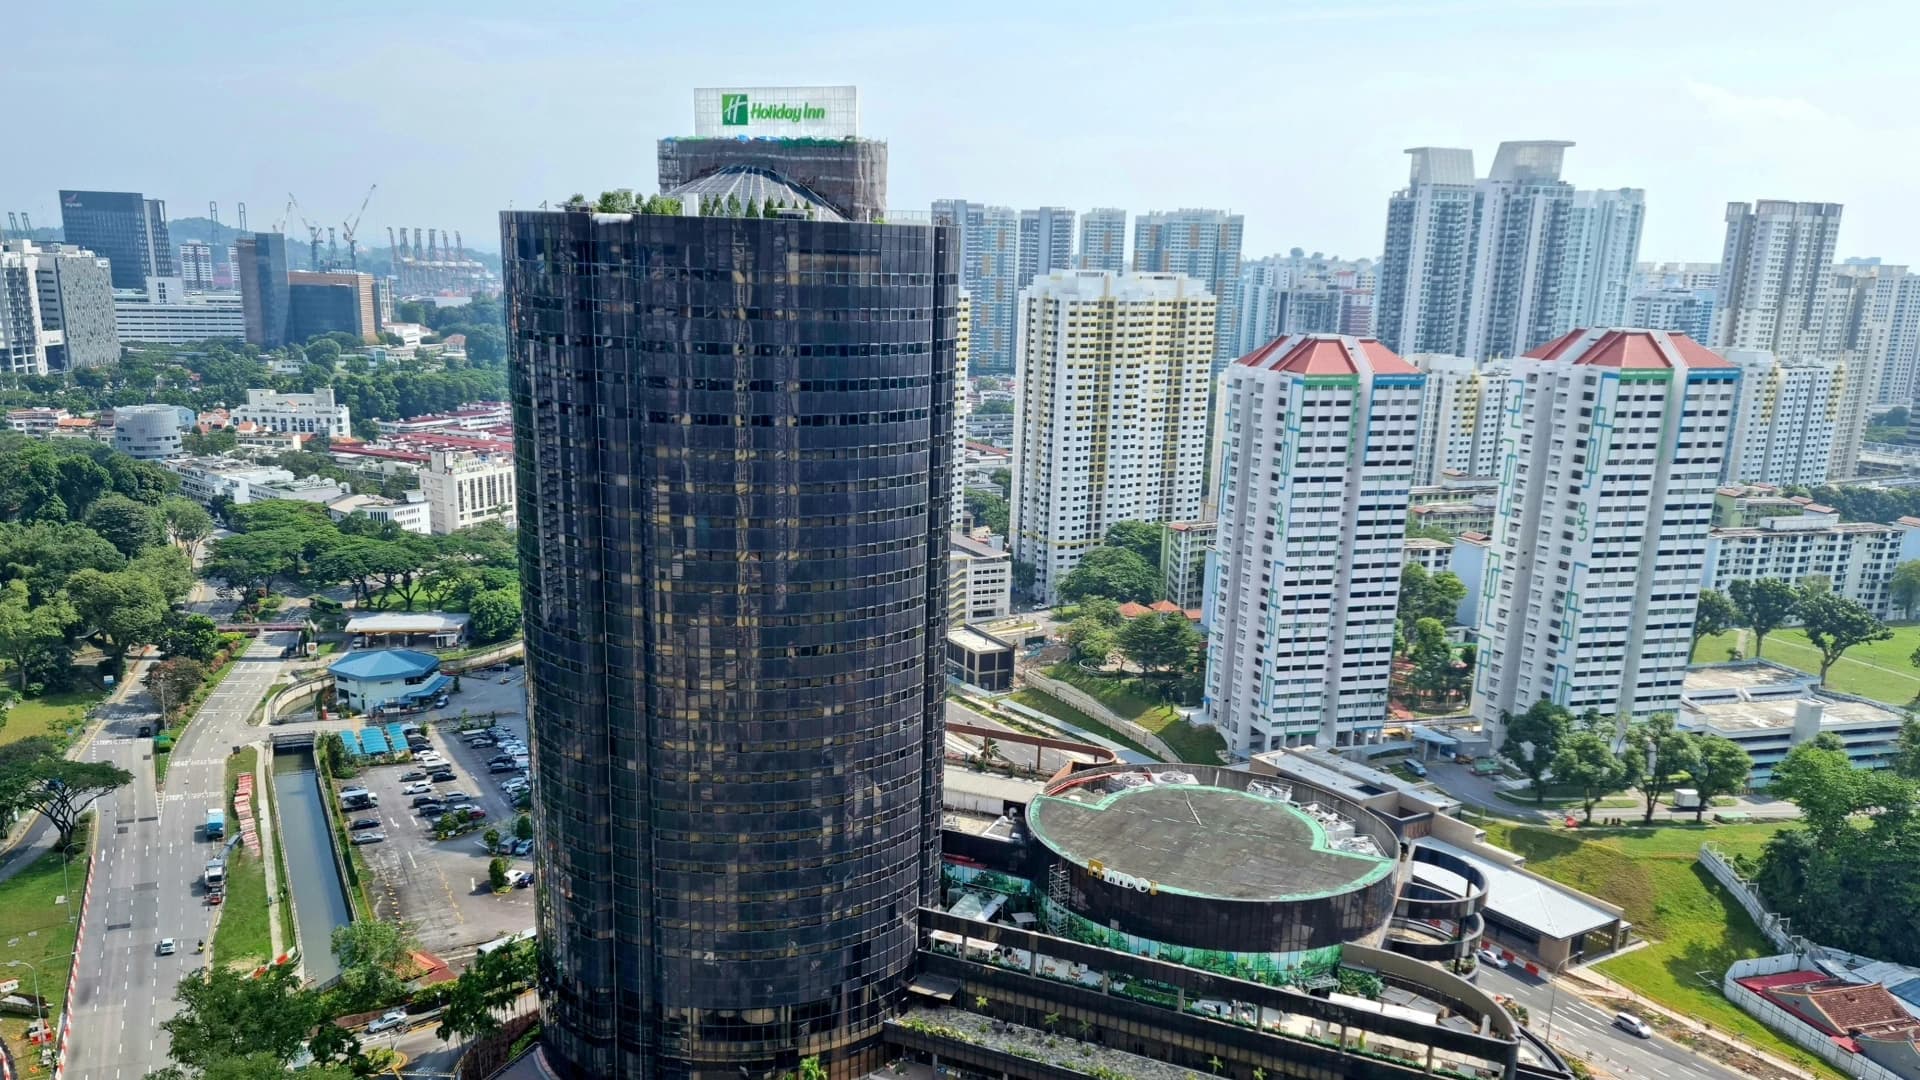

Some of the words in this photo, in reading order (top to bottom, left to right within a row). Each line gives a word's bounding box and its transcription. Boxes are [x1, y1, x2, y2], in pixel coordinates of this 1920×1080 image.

[751, 102, 802, 123] Holiday
[804, 102, 825, 119] Inn
[1276, 501, 1284, 541] 94
[1577, 501, 1589, 542] 95
